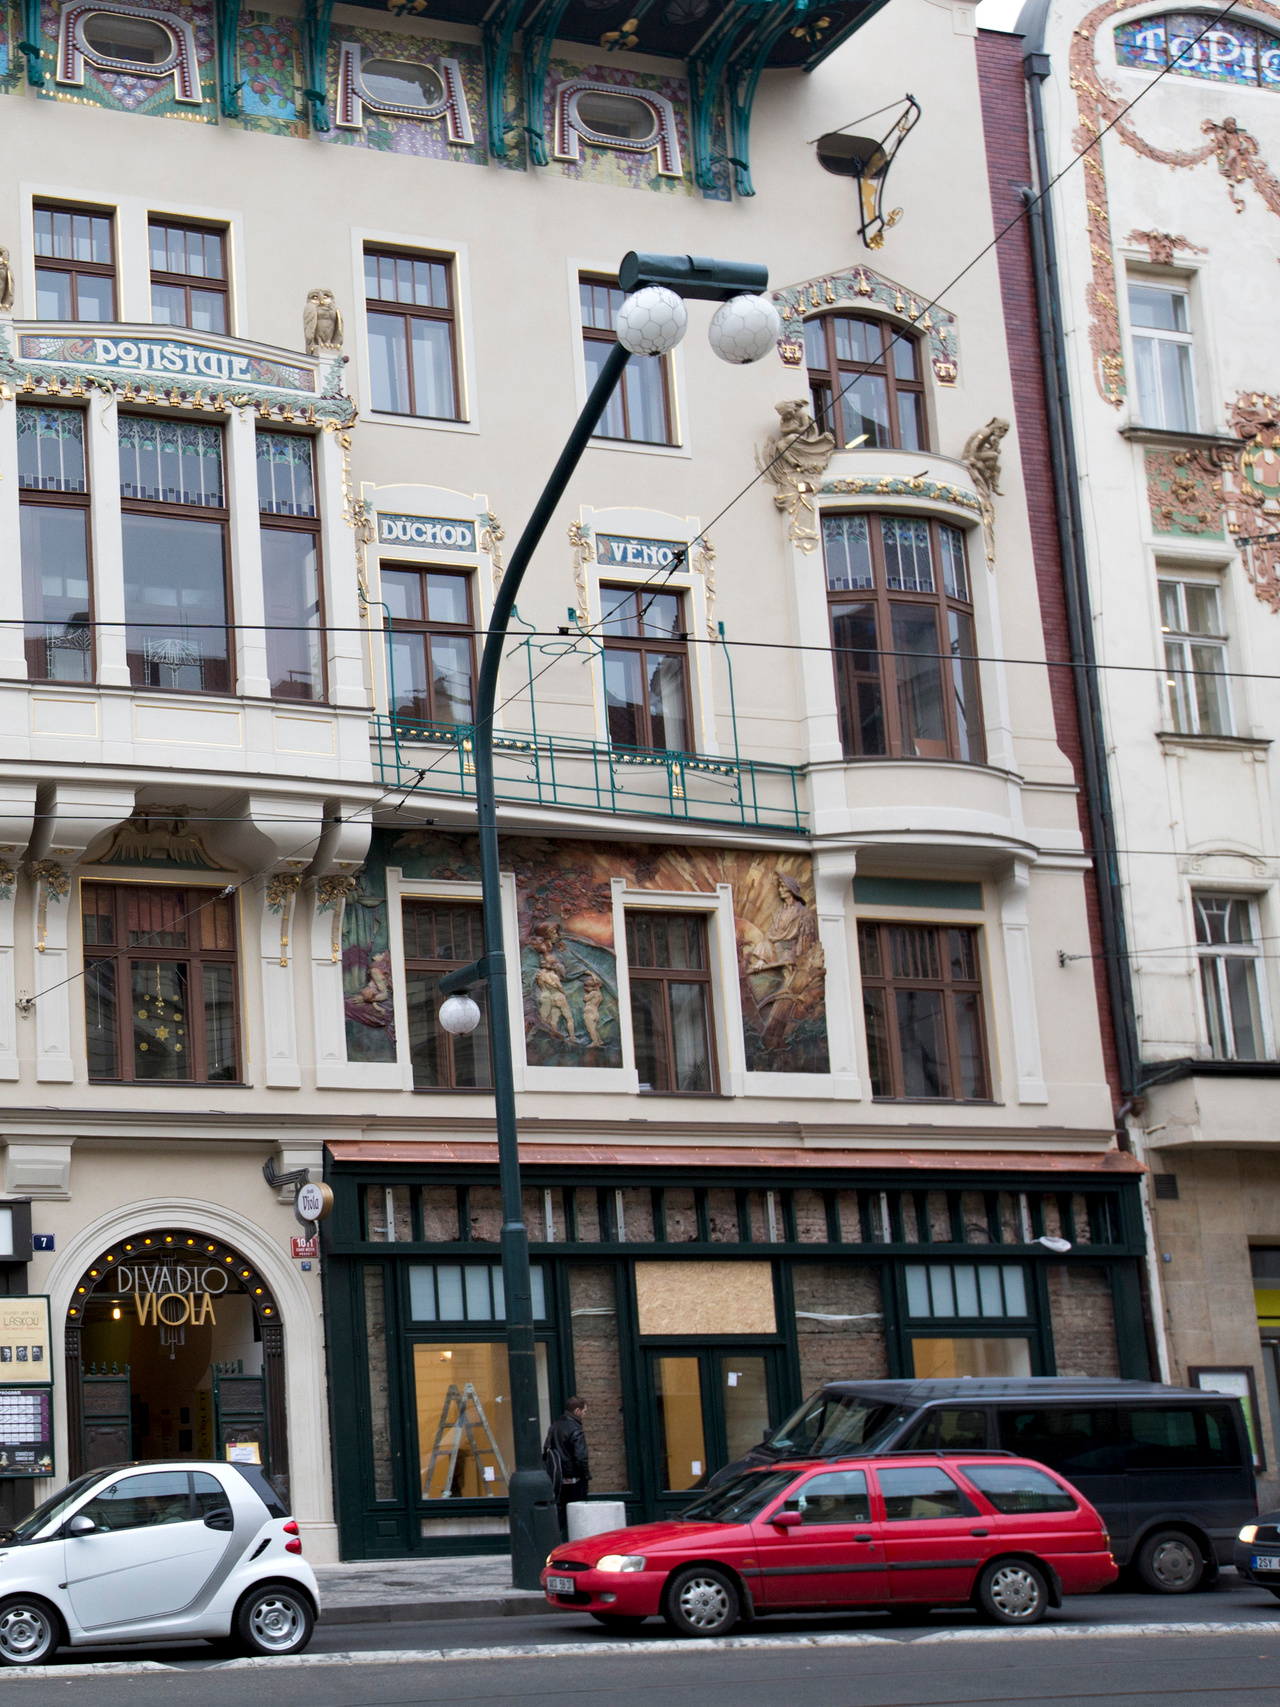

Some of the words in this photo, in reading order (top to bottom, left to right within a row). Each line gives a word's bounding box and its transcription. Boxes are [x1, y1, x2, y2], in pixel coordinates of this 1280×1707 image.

[381, 517, 472, 546] DŮCHOD
[610, 540, 672, 565] VĚNO
[302, 1195, 319, 1211] Viola
[40, 1237, 47, 1248] 7
[118, 1266, 229, 1294] DIVADLO
[134, 1292, 216, 1326] VIOLA
